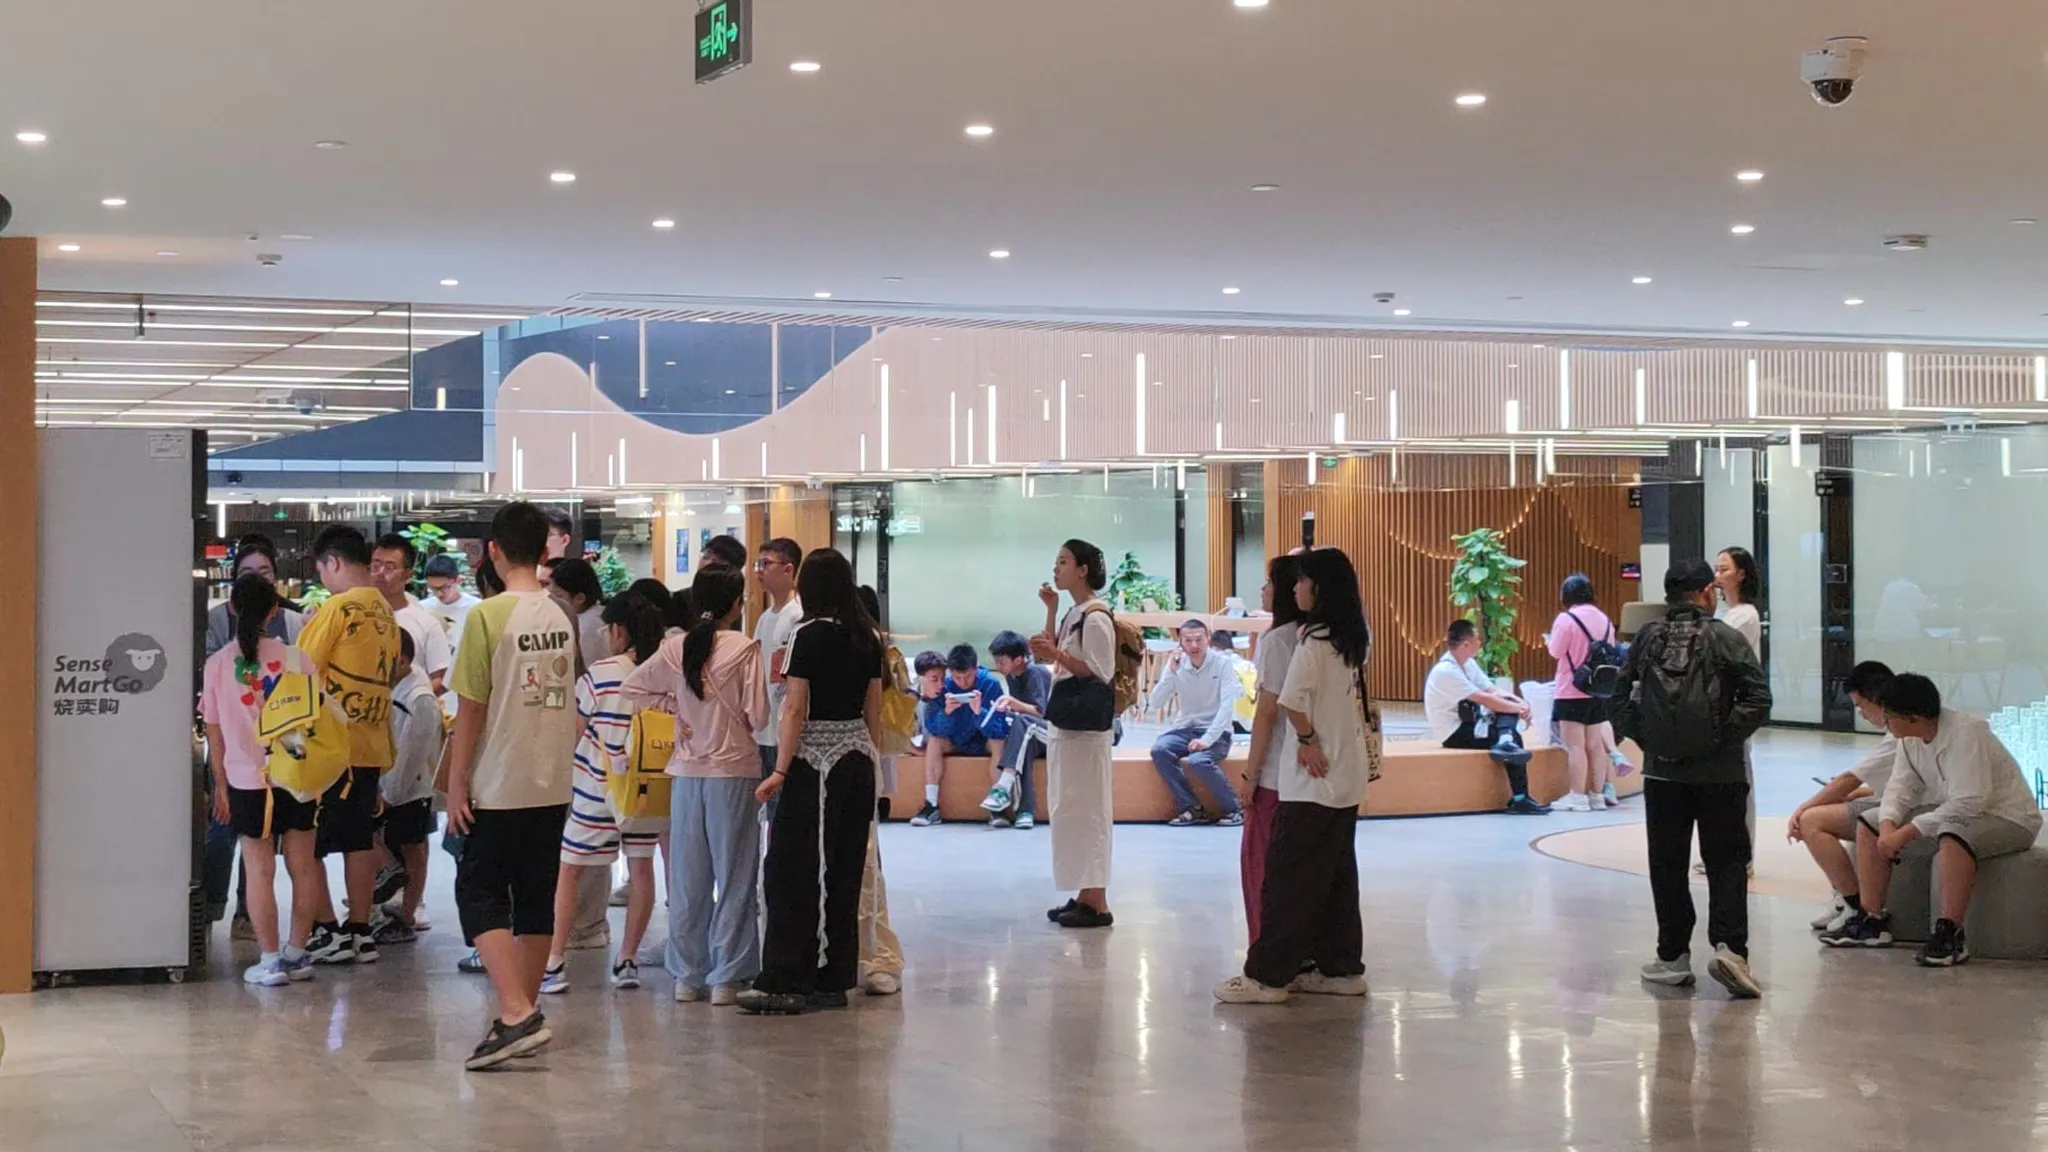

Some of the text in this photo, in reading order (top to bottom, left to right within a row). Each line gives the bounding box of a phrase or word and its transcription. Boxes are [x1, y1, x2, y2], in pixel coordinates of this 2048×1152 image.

[518, 631, 569, 652] CAMP
[54, 655, 113, 672] Sense
[54, 676, 143, 694] MartGo
[54, 698, 119, 715] 烧卖购
